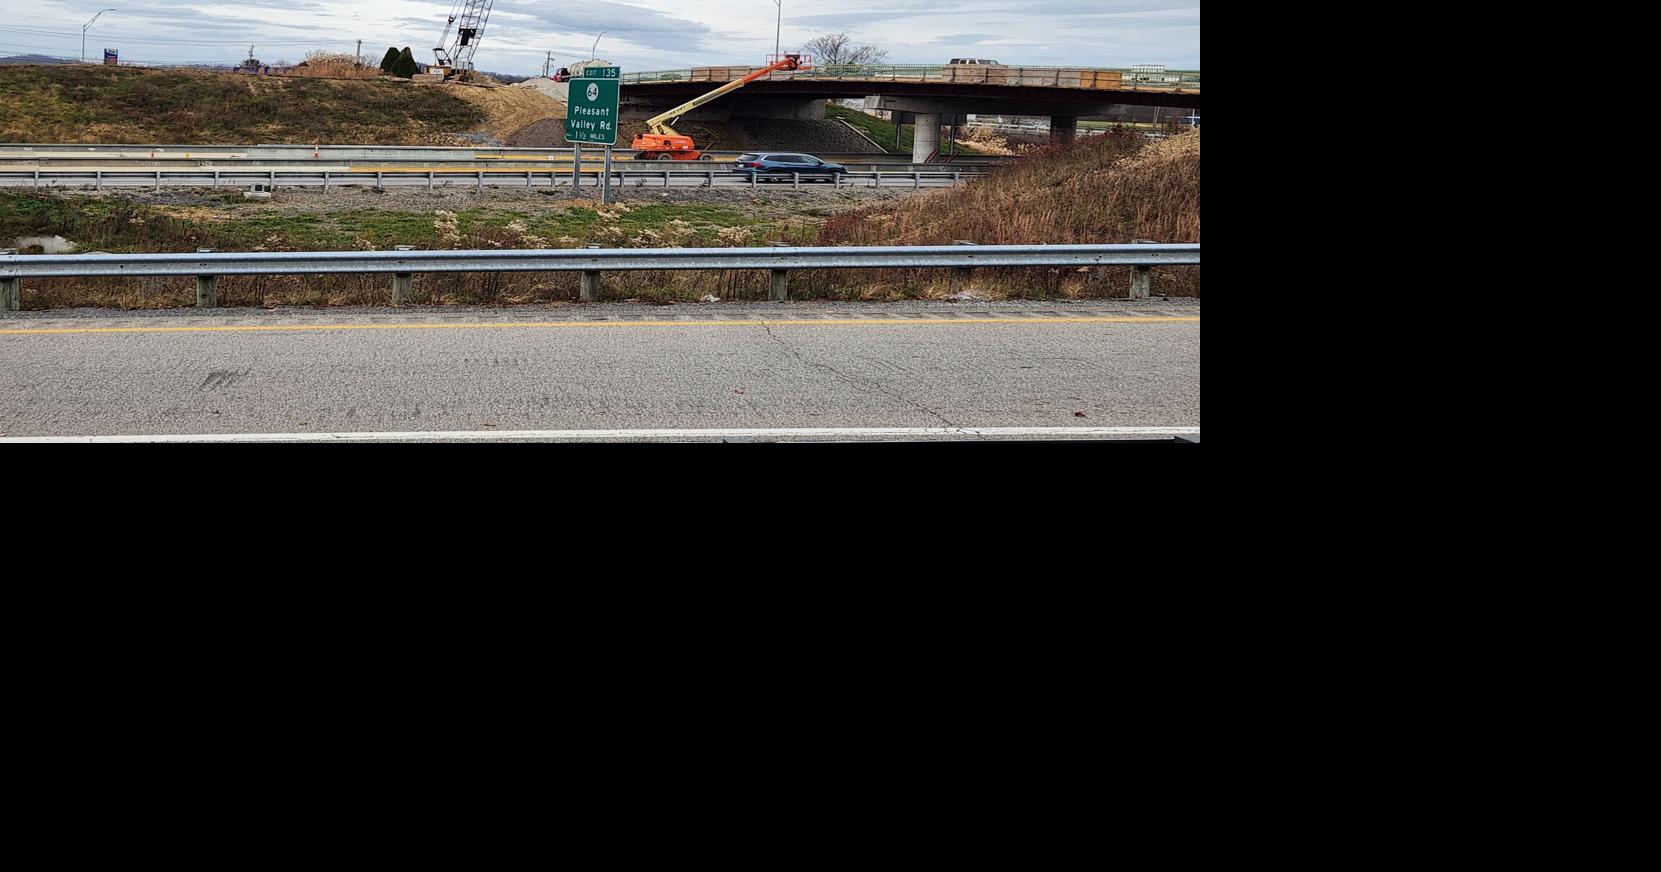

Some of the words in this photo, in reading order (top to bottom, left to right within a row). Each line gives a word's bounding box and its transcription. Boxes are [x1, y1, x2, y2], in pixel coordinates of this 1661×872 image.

[602, 68, 616, 77] 135
[587, 87, 598, 97] 64
[574, 105, 610, 116] Pleasant
[570, 119, 596, 131] Valley
